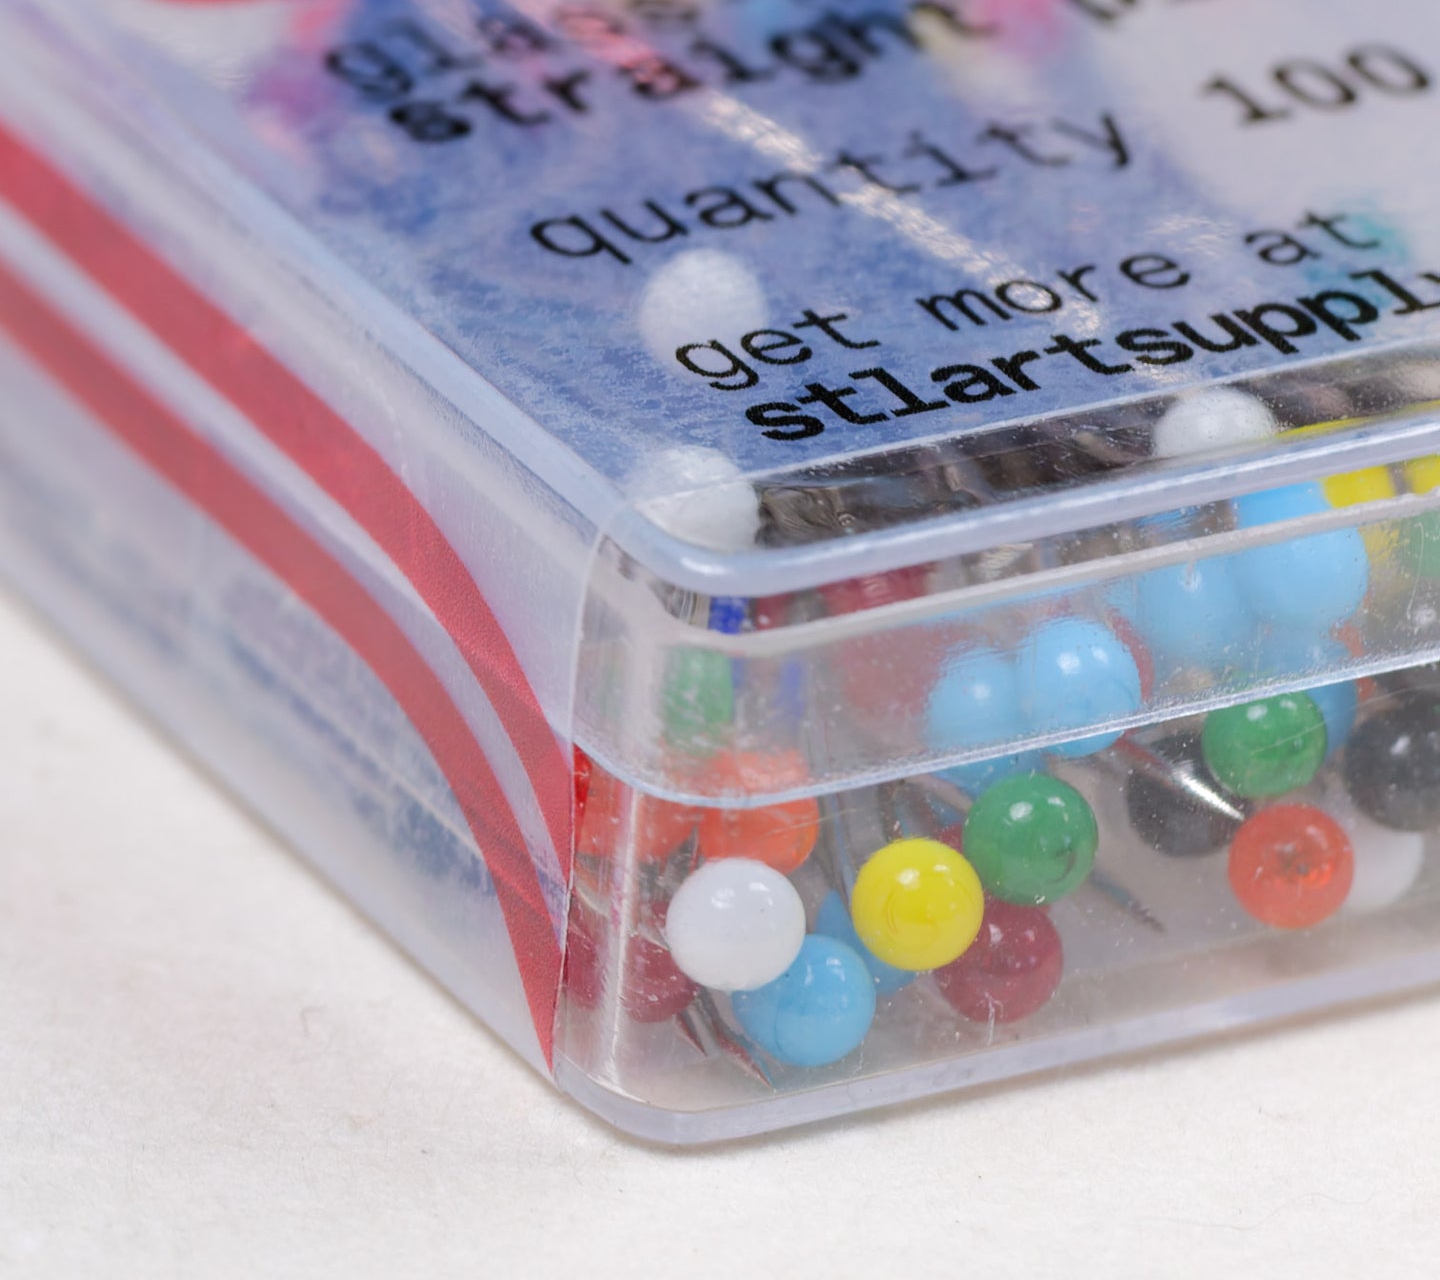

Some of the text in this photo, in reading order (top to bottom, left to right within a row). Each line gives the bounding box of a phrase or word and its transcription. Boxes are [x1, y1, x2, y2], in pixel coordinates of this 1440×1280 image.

[530, 39, 1435, 266] quantity 100
[673, 209, 1382, 392] get more at
[745, 267, 1440, 442] stlartsuppl
